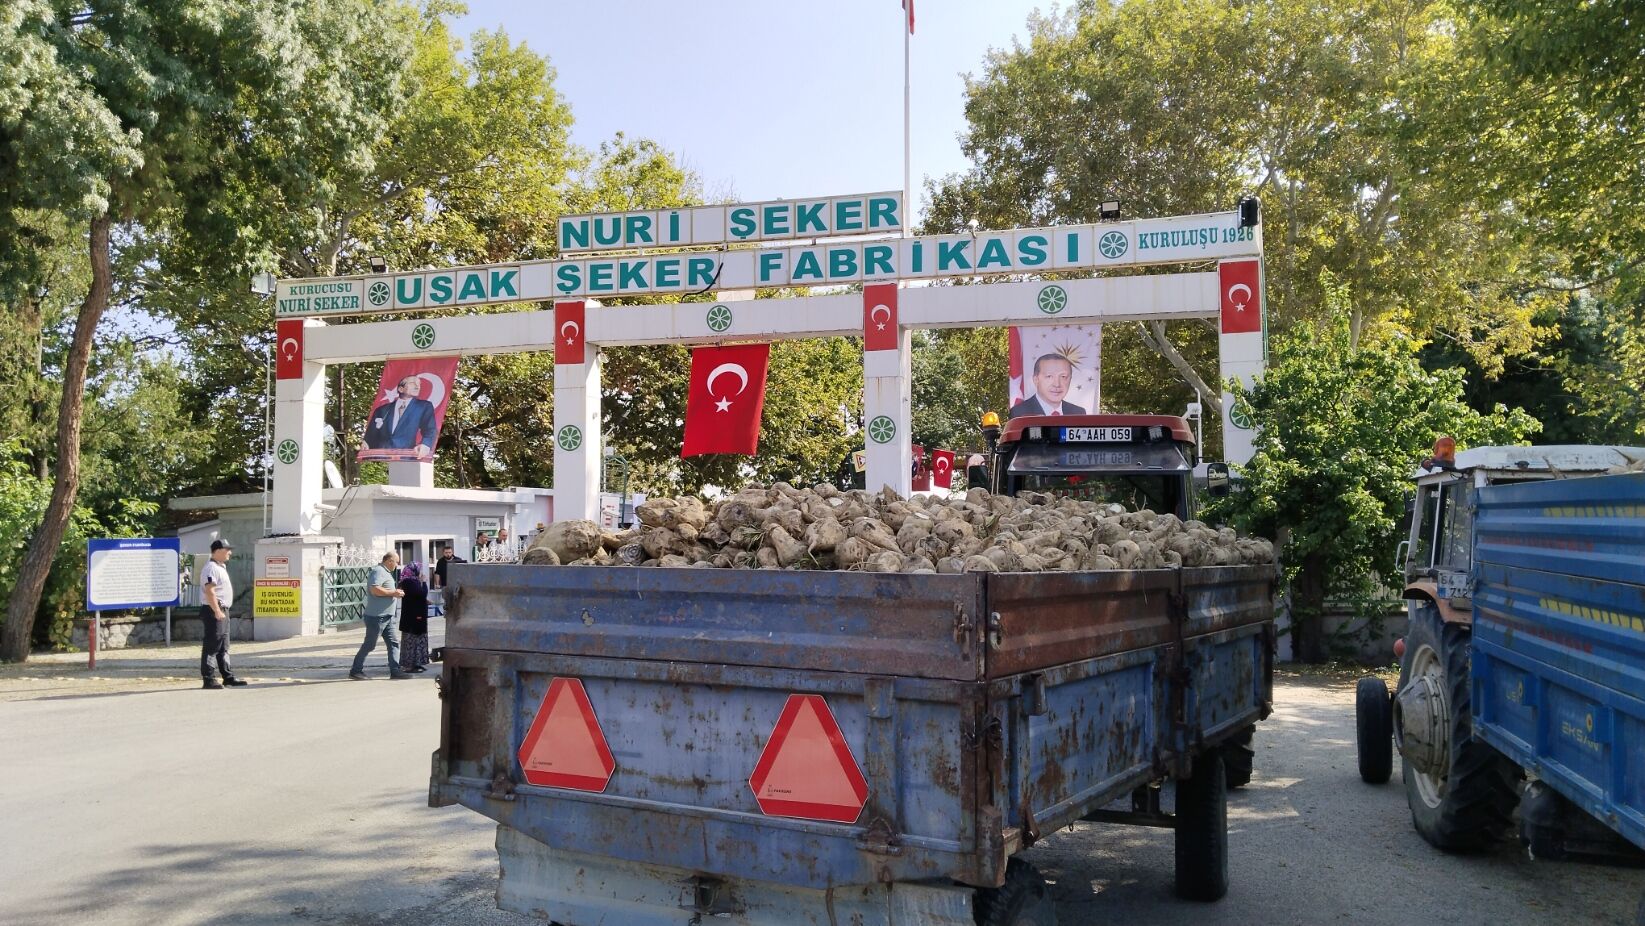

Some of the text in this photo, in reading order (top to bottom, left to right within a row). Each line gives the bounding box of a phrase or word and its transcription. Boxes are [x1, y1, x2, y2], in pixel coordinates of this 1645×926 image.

[562, 198, 900, 249] NURİ ŞEKER
[1138, 226, 1254, 250] KURULUŞU 1926
[397, 233, 1079, 305] UŞAK ŞEKER FABRİKASI
[289, 283, 353, 296] KURUCUSU
[278, 296, 359, 313] NURİ ŞEKER
[1069, 428, 1131, 440] 64 AAH 059
